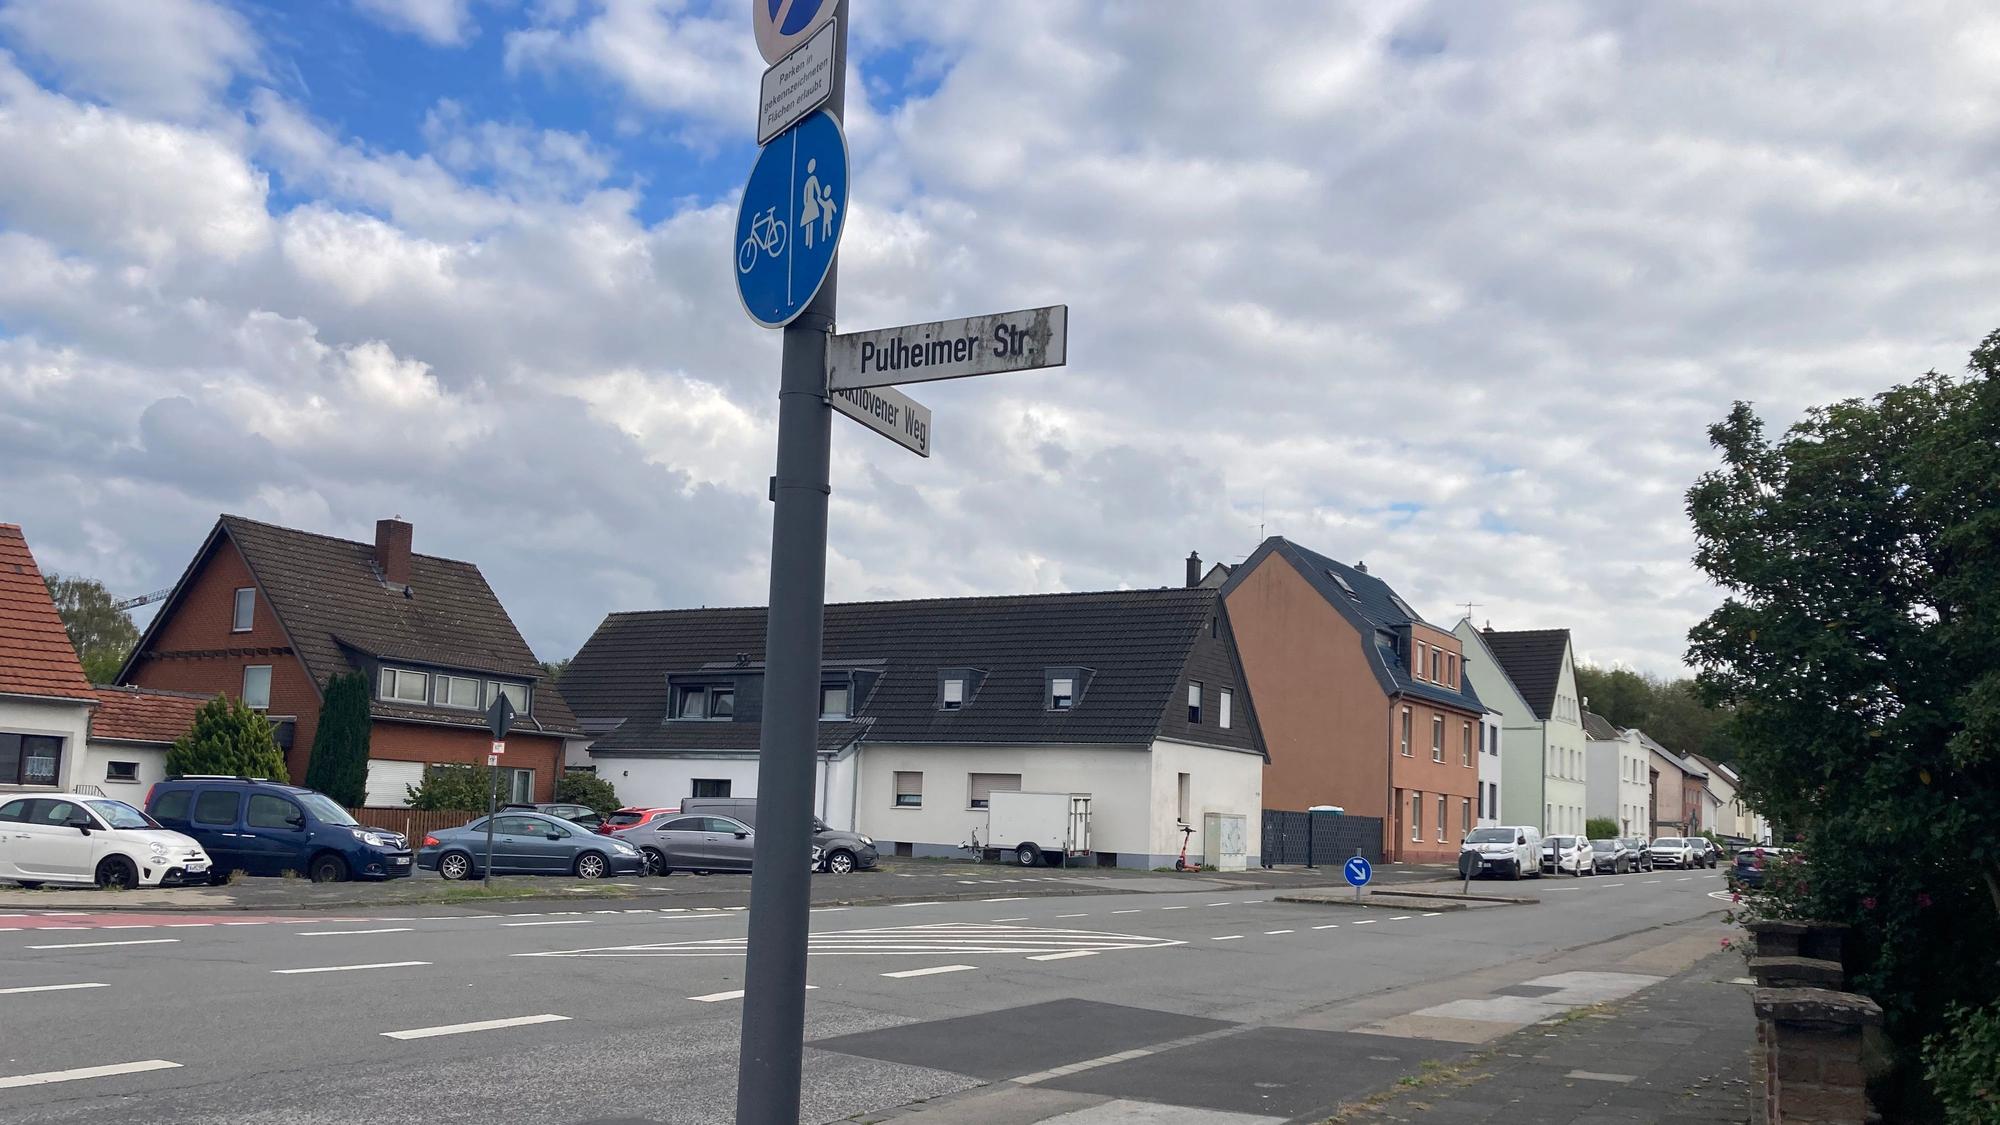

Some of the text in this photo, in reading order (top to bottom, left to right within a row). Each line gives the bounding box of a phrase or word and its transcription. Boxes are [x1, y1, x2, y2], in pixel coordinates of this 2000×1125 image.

[764, 58, 828, 114] gekennzeichneten
[779, 54, 813, 86] Parken in
[767, 79, 822, 125] Flächen erlaubt
[861, 323, 1033, 373] Pulheimer Str.
[905, 404, 926, 450] Weg
